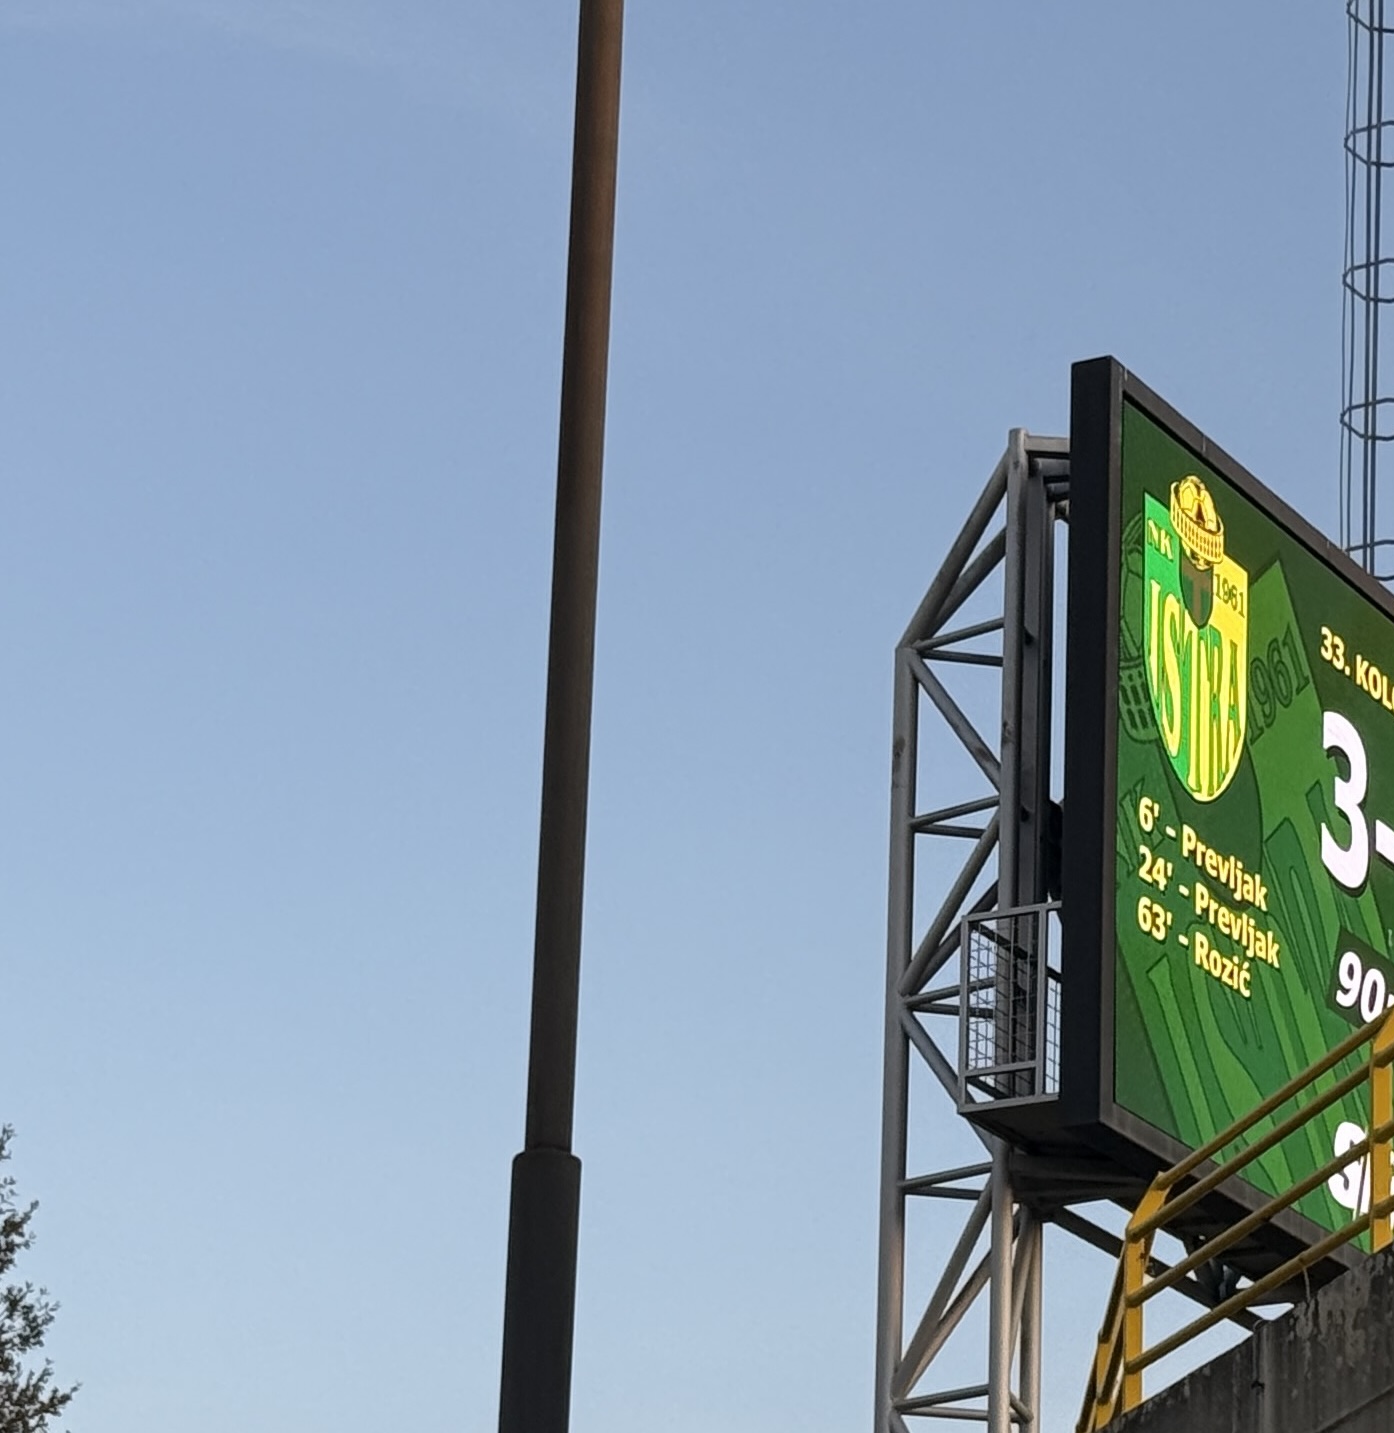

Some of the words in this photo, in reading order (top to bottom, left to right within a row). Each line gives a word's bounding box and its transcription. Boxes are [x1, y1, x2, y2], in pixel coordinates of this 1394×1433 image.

[1146, 517, 1173, 563] NK
[1214, 574, 1245, 618] 1961
[1149, 578, 1244, 796] ISTRA
[1320, 626, 1350, 676] 33.
[1139, 797, 1159, 832] 6'
[1182, 824, 1268, 912] Prevljak
[1137, 897, 1172, 941] 63'
[1195, 931, 1250, 998] Rozić
[1139, 845, 1173, 891] 24'
[1195, 882, 1280, 969] Prevljak
